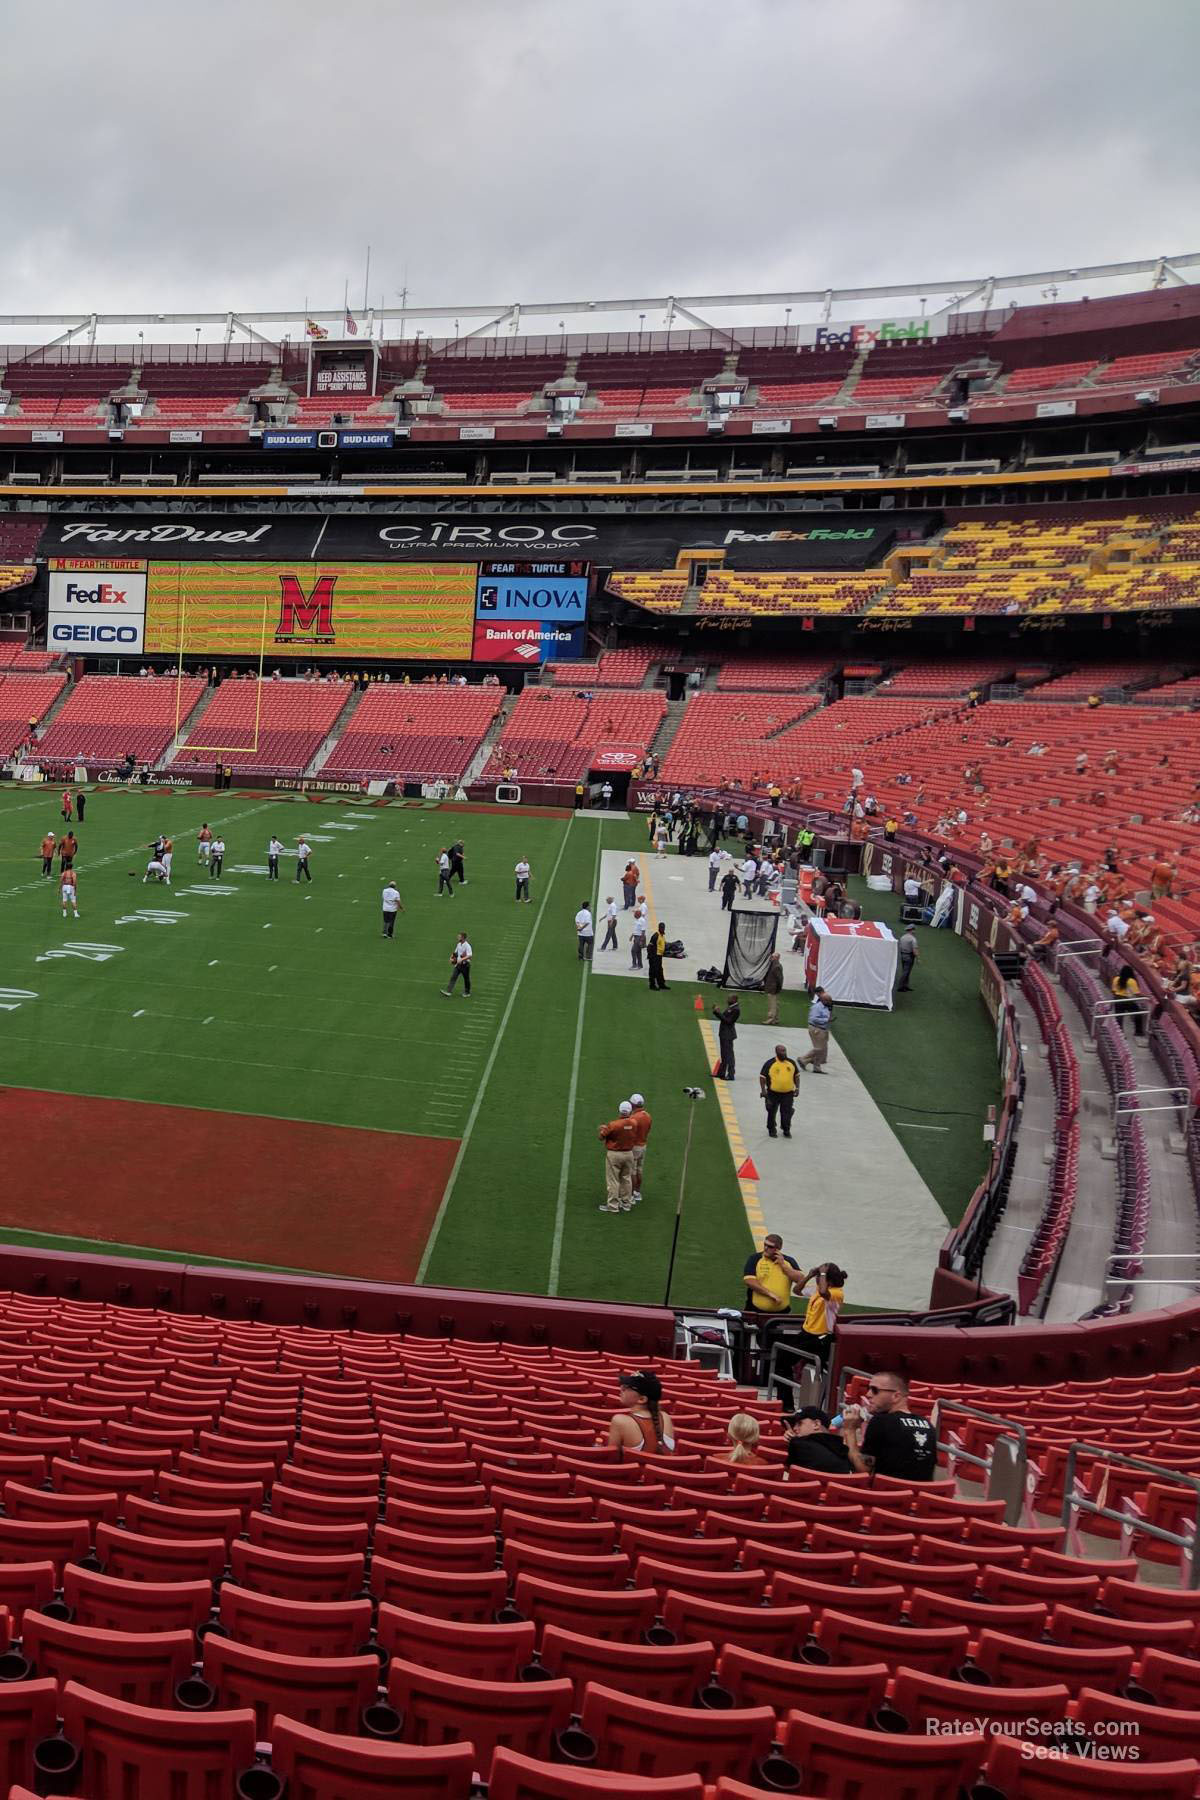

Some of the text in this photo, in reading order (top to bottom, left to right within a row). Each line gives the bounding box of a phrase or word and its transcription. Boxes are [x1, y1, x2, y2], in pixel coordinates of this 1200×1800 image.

[816, 319, 930, 345] FedExField
[318, 371, 367, 382] NEED ASSISTANCE
[267, 436, 312, 444] BUD LIGHT
[343, 435, 389, 444] BUD LIGHT
[60, 523, 272, 543] FanDuel
[724, 528, 875, 544] FedExField
[524, 541, 581, 549] VODKA
[56, 560, 66, 569] M
[66, 583, 127, 604] FedEx
[505, 589, 582, 608] INOVA
[275, 576, 338, 635] M
[52, 624, 138, 642] GEICO
[486, 628, 572, 641] Bank of America
[42, 942, 127, 962] 20
